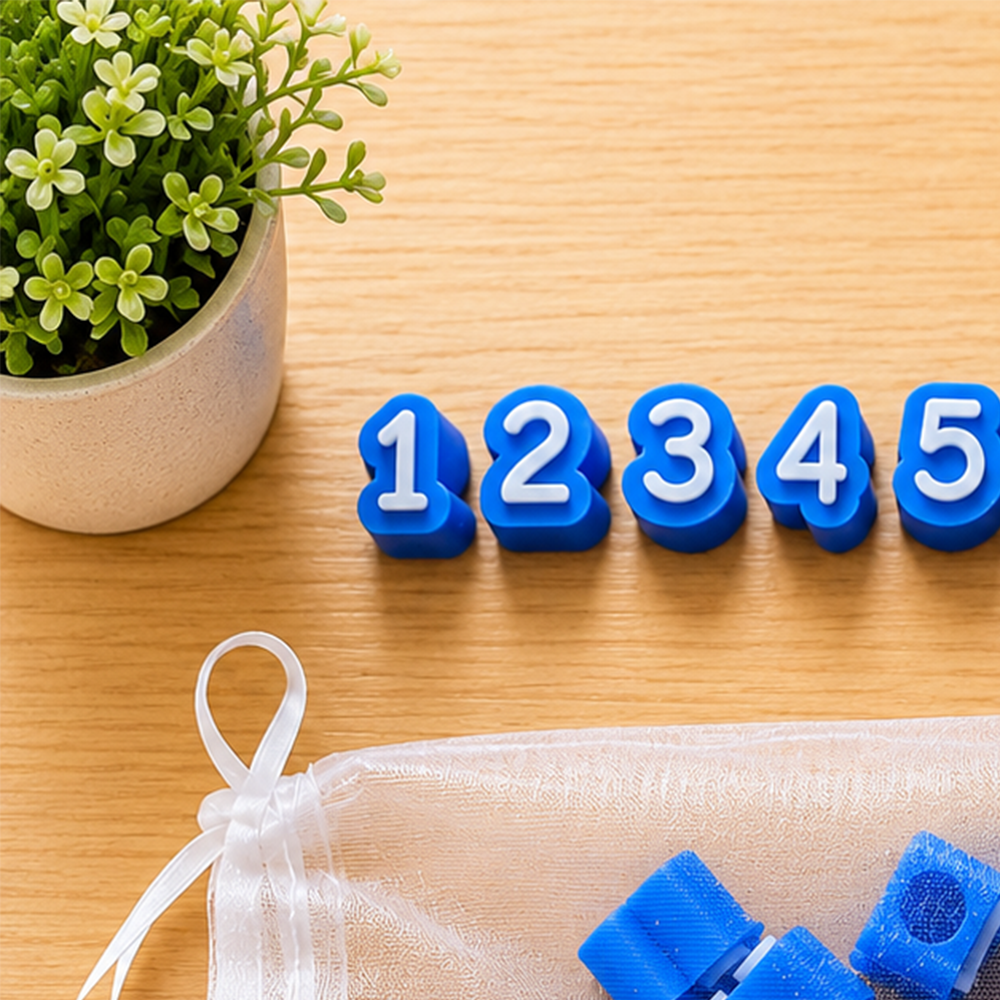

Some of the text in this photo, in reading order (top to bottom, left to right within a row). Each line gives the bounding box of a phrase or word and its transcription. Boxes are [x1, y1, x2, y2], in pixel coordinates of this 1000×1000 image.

[378, 410, 427, 509] 1
[502, 401, 569, 502] 2
[644, 399, 713, 501] 3
[777, 401, 846, 503] 4
[915, 399, 984, 500] 5
